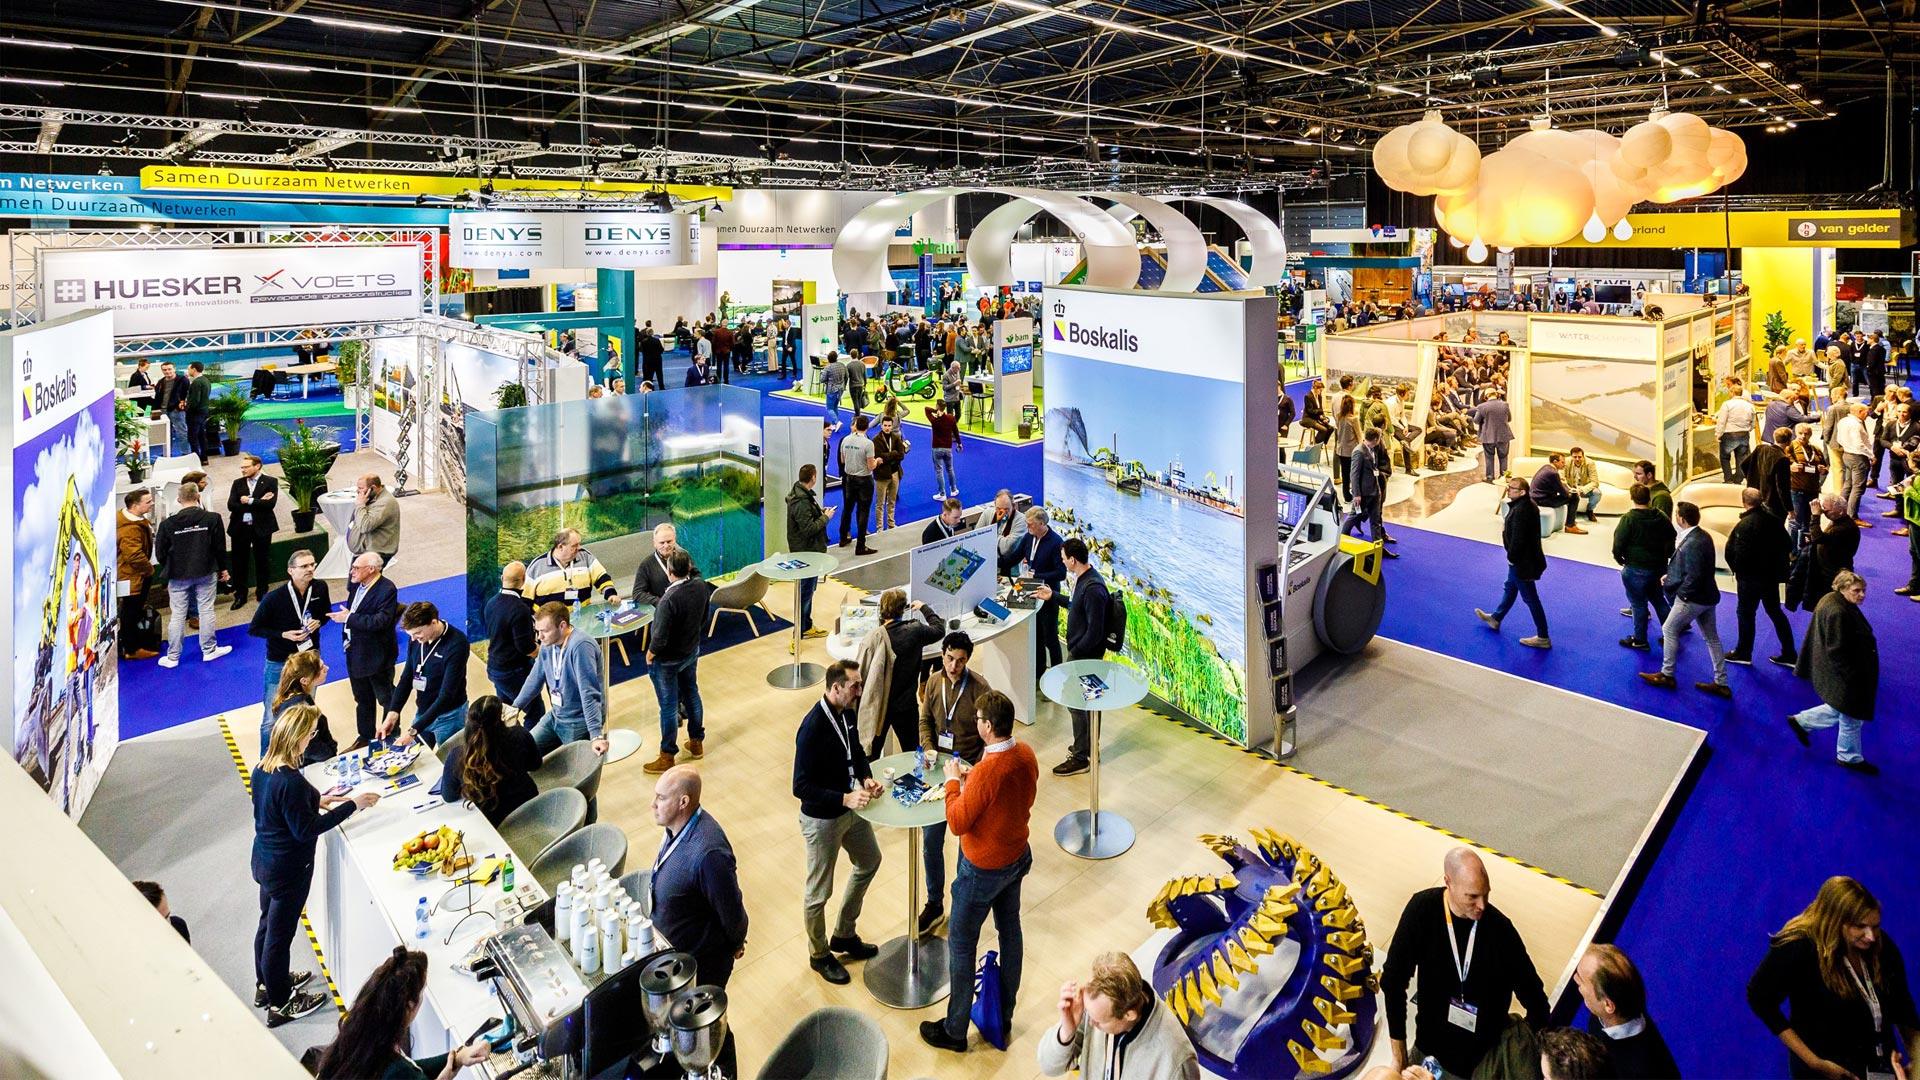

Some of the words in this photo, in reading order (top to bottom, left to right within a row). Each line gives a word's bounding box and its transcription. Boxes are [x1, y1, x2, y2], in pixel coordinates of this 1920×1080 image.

[20, 176, 124, 192] Netwerken
[154, 169, 220, 184] Samen
[227, 172, 318, 188] Duurzaam
[324, 176, 411, 191] Netwerken
[51, 197, 145, 214] Duurzaam
[152, 200, 236, 217] Netwerken
[463, 227, 542, 241] DENYS
[584, 227, 671, 241] DENYS
[739, 225, 784, 234] Duurzaam
[786, 225, 836, 235] Netwerken
[1820, 225, 1843, 233] van
[1847, 223, 1890, 235] gelder
[463, 249, 543, 258] www.denys.com
[584, 247, 671, 256] www.denys.com
[928, 238, 958, 255] bam
[94, 276, 242, 300] HUESKER
[291, 273, 396, 289] VOETS
[129, 301, 182, 310] Engineers.
[185, 298, 242, 307] Innovations.
[1014, 333, 1030, 342] bam
[1069, 321, 1139, 353] Boskalis
[35, 368, 77, 415] Boskalis
